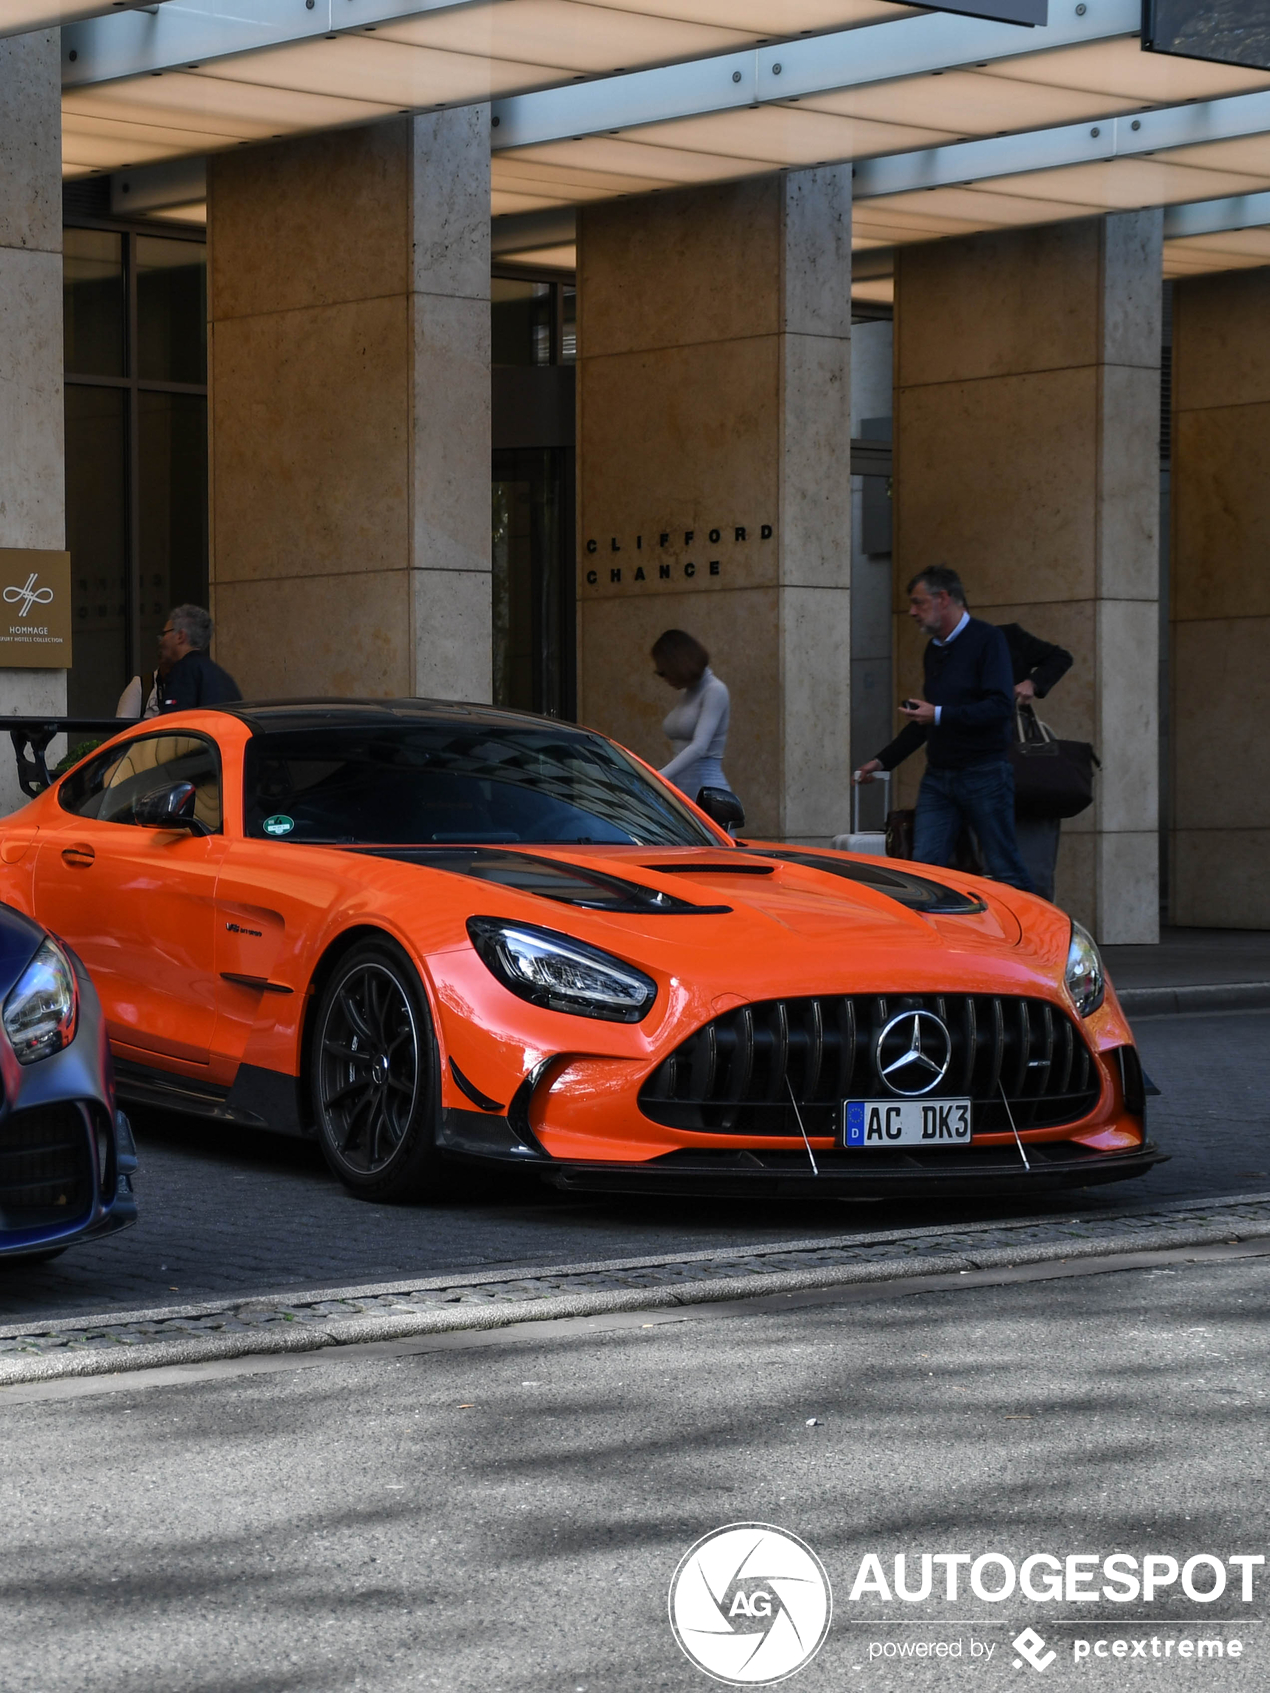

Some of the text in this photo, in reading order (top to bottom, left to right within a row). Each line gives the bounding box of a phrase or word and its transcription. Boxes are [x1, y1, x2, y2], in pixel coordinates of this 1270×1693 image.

[587, 525, 772, 553] CLIFFORD
[587, 561, 720, 584] CHANCE
[9, 626, 48, 635] HOMMAGE
[851, 1128, 859, 1138] D
[867, 1107, 902, 1140] AC
